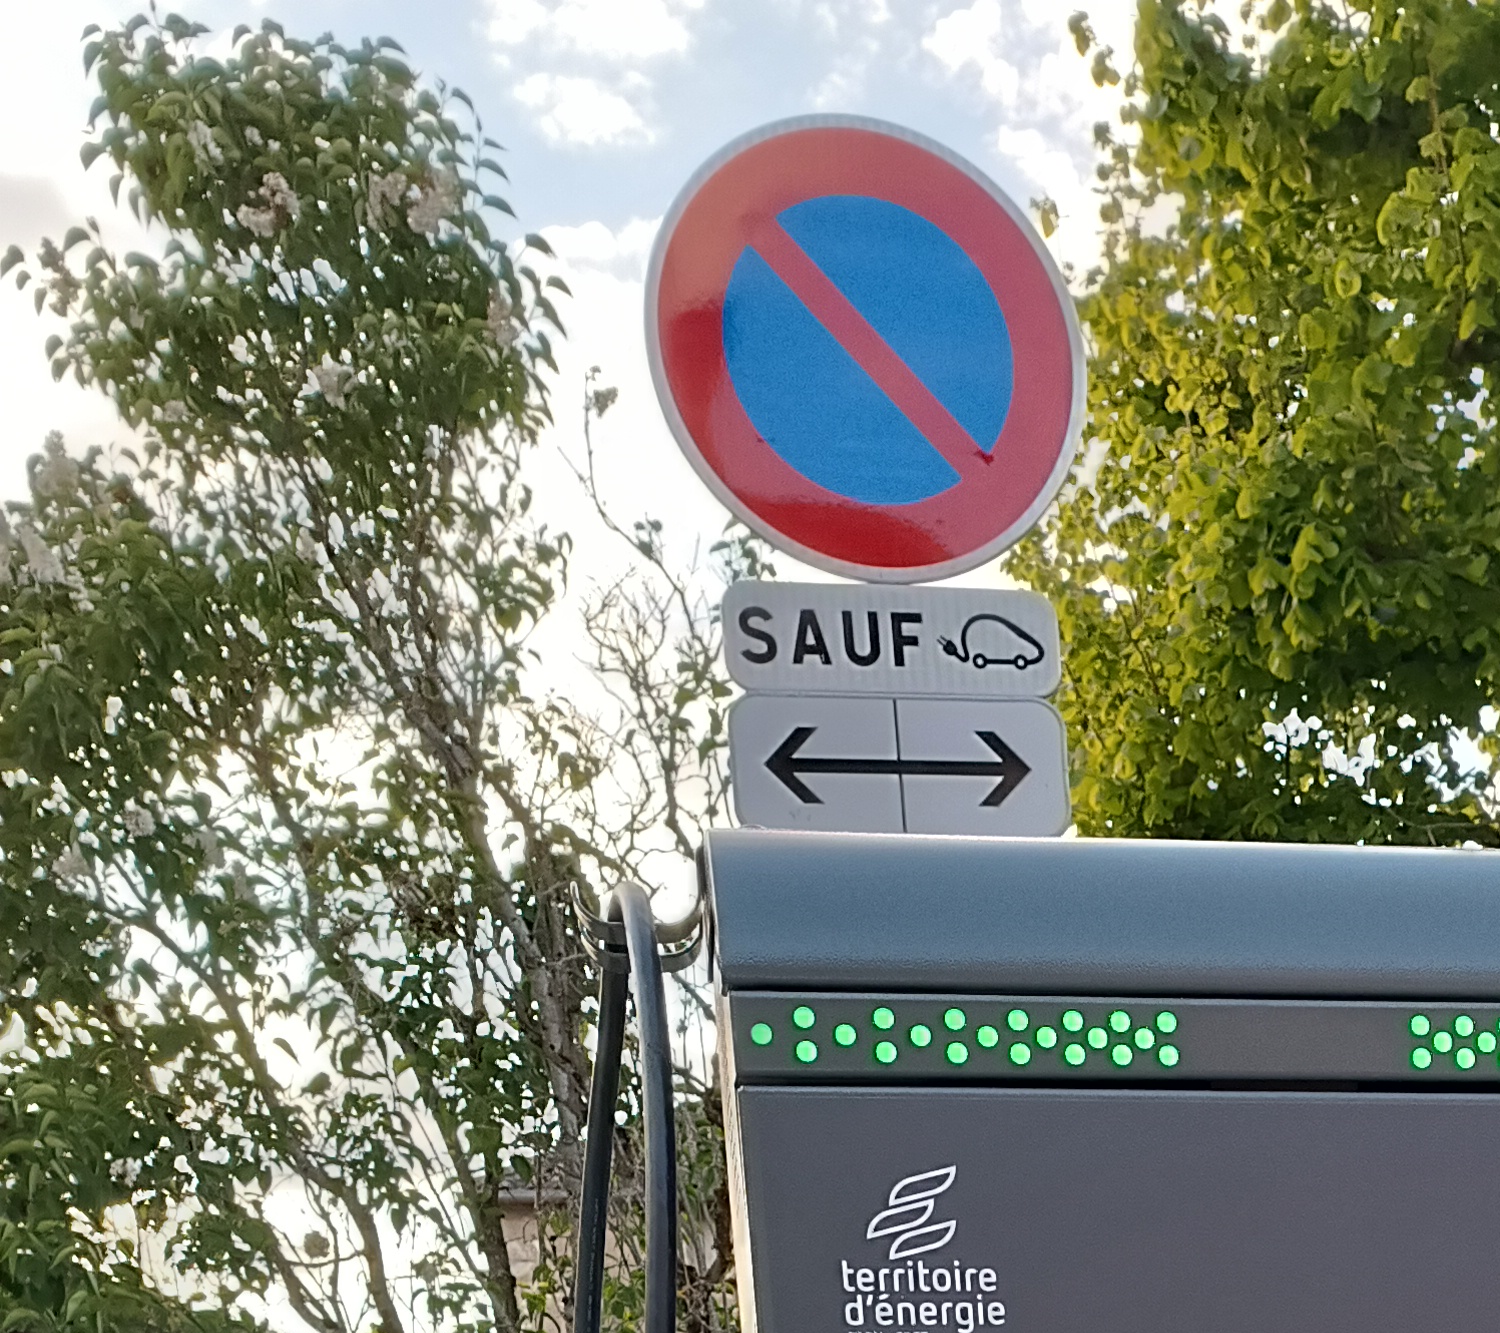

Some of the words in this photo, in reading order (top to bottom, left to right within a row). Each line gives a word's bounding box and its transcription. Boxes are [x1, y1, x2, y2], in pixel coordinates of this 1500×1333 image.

[738, 606, 923, 667] SAUF
[841, 1260, 997, 1292] territoire
[845, 1293, 1006, 1333] d'énergie
